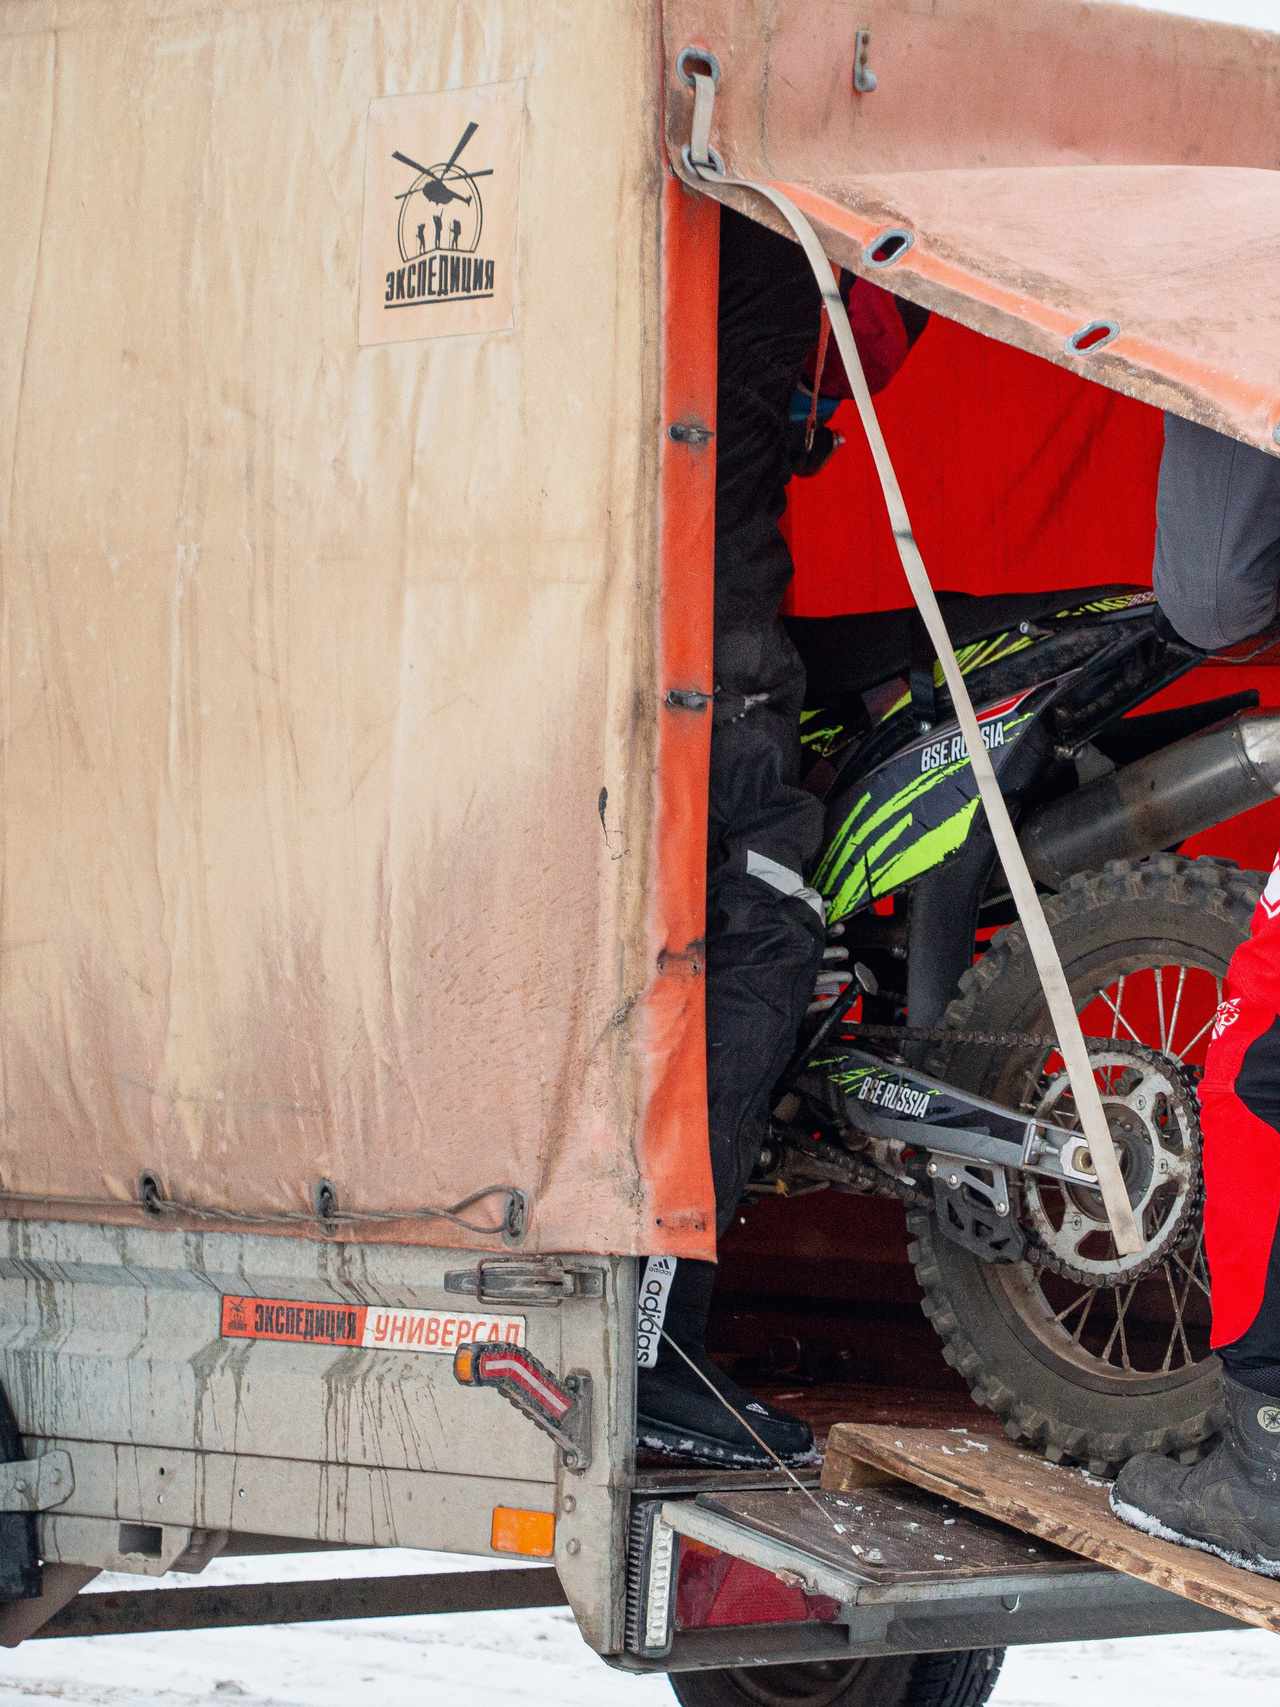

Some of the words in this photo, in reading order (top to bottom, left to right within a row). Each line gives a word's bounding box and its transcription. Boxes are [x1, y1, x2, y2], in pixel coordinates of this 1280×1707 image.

[385, 254, 495, 301] ЭКСПЕДИЦИЯ
[921, 740, 949, 773] BSE
[951, 721, 1004, 762] RUSIA
[858, 1076, 886, 1104] BSE
[880, 1082, 931, 1118] RUSSIA
[648, 1266, 673, 1277] adidas
[254, 1304, 357, 1342] ЭКСПЕДИЦИЯ
[638, 1280, 661, 1362] adidas
